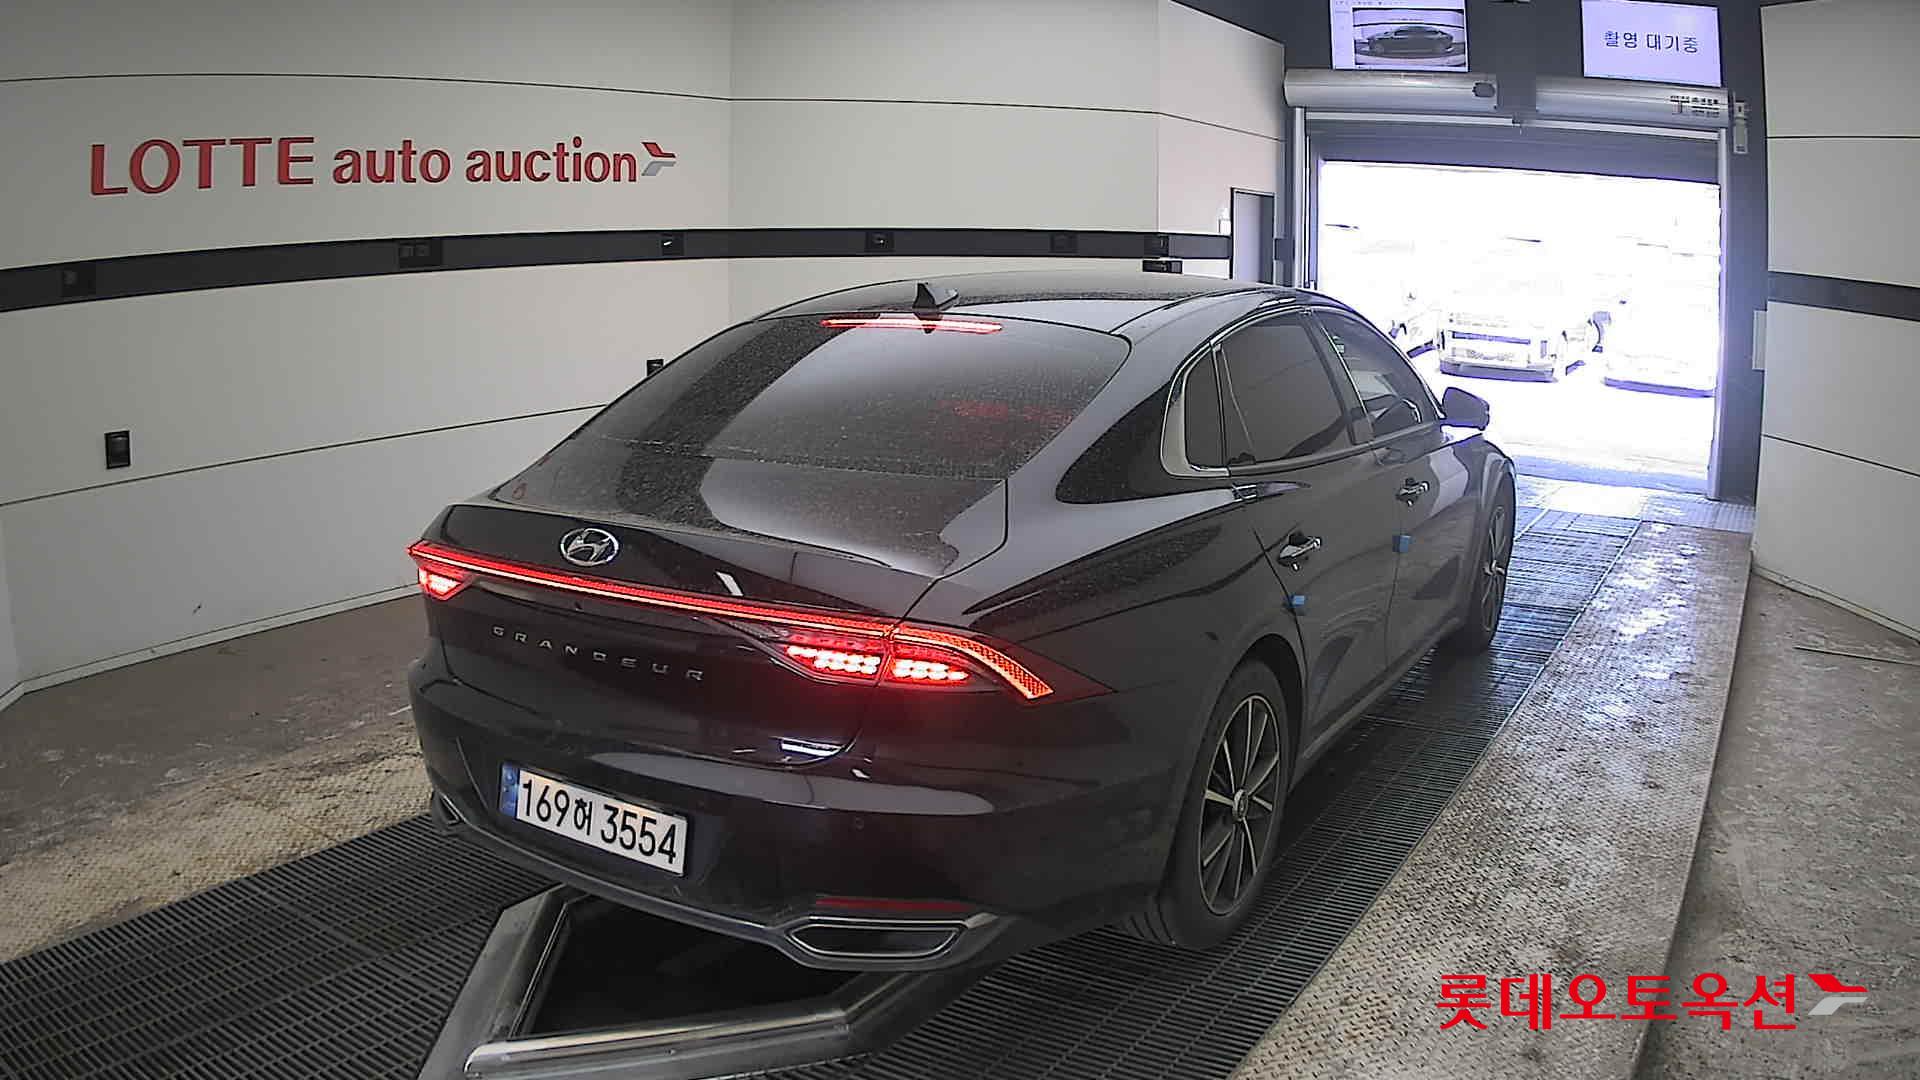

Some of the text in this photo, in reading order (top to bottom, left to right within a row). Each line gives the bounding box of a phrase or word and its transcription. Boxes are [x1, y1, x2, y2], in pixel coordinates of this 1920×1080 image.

[1646, 33, 1698, 54] 대기중
[90, 136, 637, 195] LOTTE auto auction
[492, 625, 704, 681] GRANDEUR
[522, 779, 677, 865] 169허 3554
